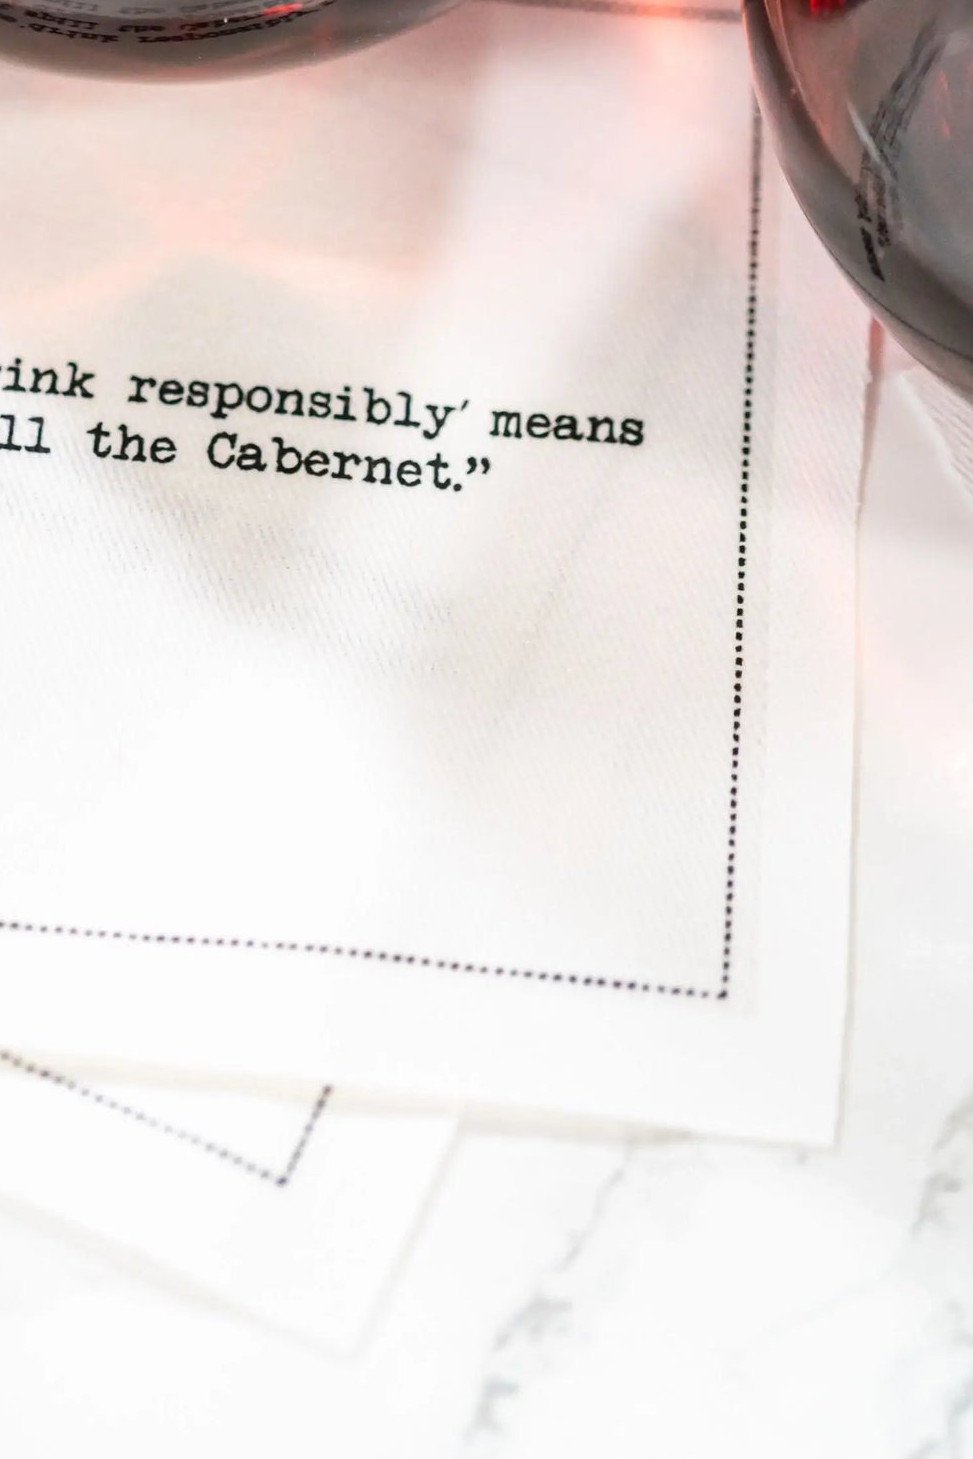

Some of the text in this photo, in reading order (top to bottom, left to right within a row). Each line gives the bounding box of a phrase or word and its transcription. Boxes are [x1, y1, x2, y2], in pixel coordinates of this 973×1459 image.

[489, 410, 645, 447] means
[86, 421, 178, 465] the
[206, 430, 491, 493] Cabernet.”
